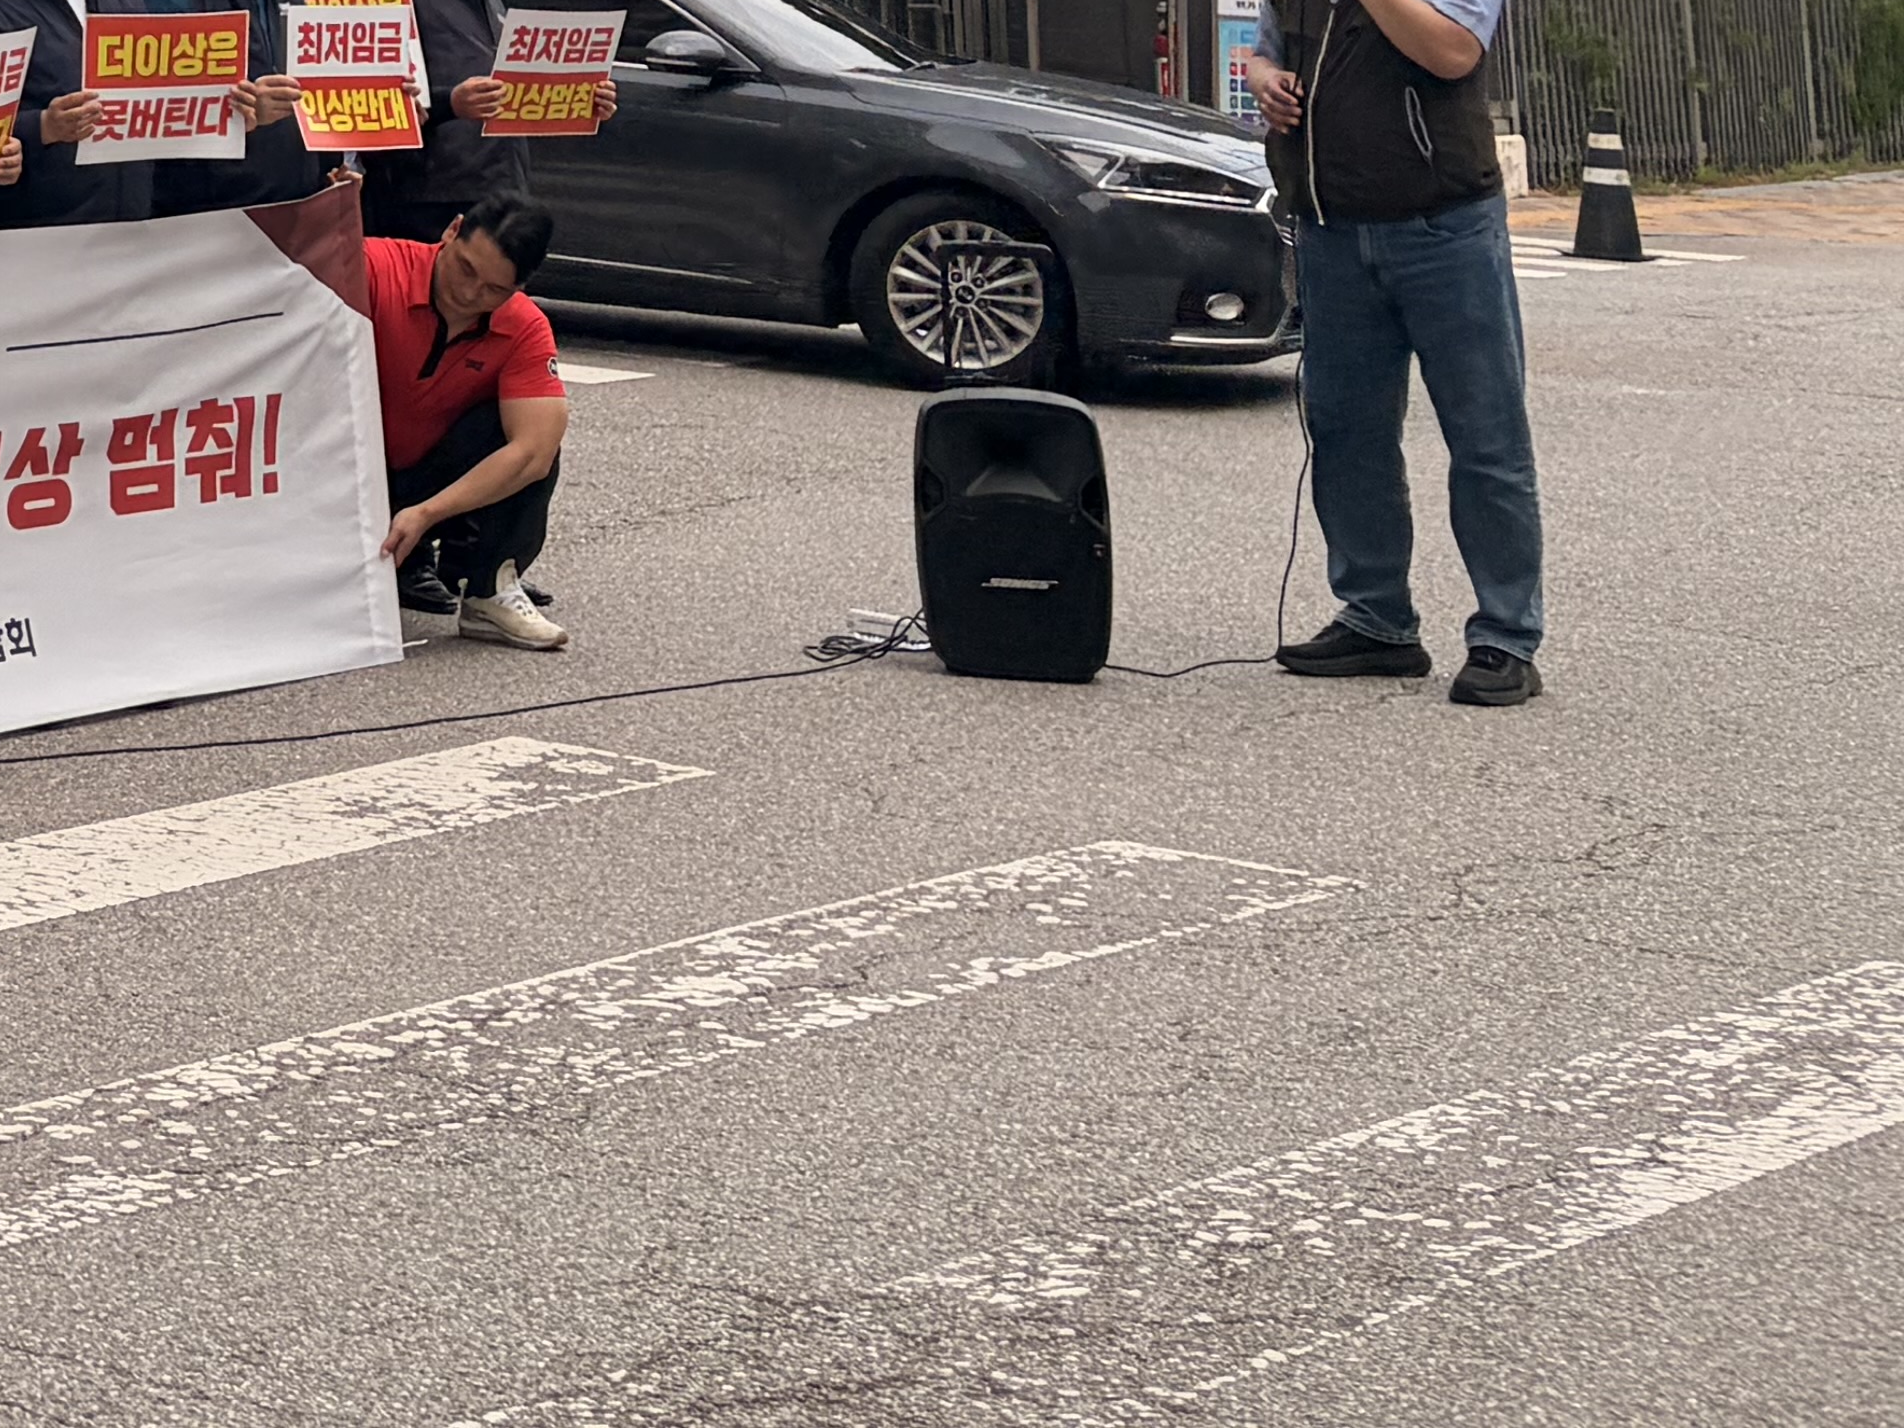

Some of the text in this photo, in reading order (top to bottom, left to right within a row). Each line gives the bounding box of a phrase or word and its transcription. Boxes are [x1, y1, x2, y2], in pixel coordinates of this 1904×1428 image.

[96, 30, 239, 78] 더이상은
[297, 22, 402, 64] 최저임금
[505, 25, 615, 64] 최저임금
[92, 95, 233, 143] 못버틴다
[299, 88, 409, 133] 인상반대
[497, 82, 597, 121] 인상멈춰
[106, 392, 283, 516] 멈춰!
